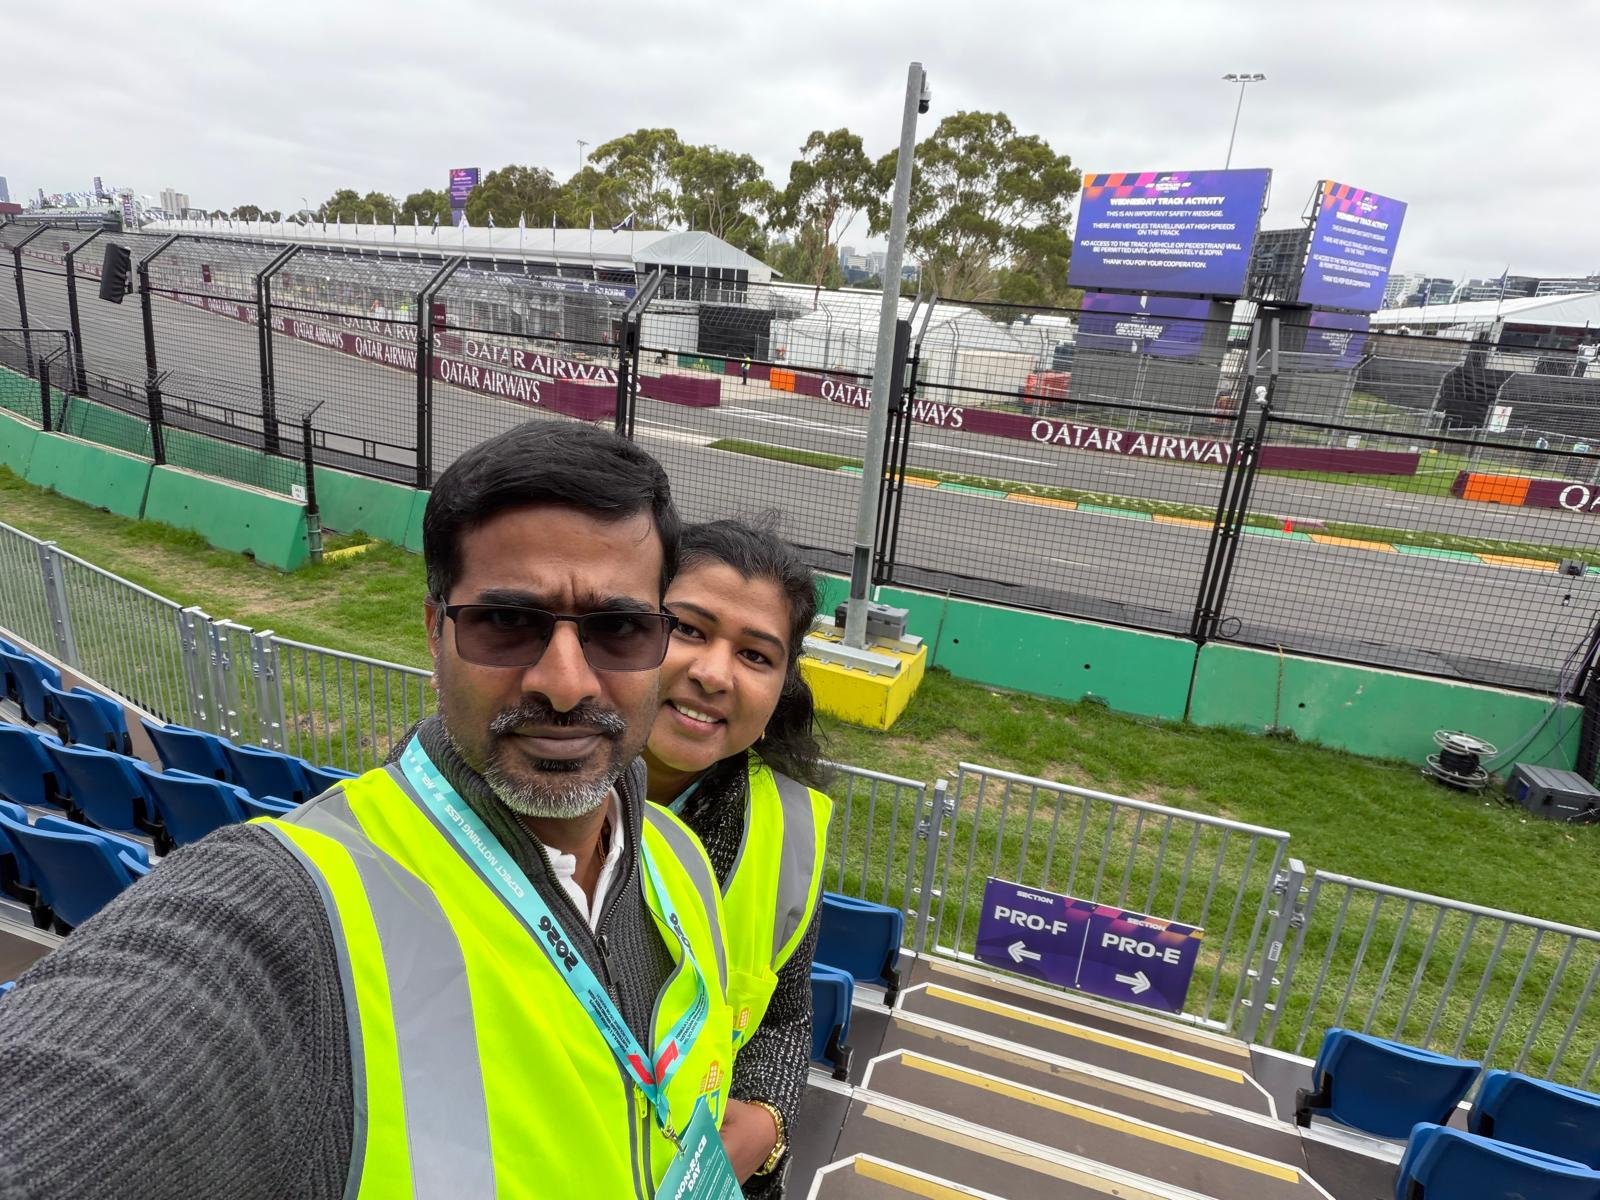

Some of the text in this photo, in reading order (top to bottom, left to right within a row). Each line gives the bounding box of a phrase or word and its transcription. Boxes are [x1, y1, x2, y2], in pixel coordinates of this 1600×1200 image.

[1158, 197, 1184, 206] TRACK
[1185, 196, 1226, 205] ACTIVITY
[355, 336, 418, 370] QATAR AIRWAY
[466, 340, 525, 368] QATAR
[440, 359, 540, 403] QATAR AIRWAYS
[1031, 420, 1122, 453] QATAR
[444, 804, 525, 898] EXPECT NOTHING LESS
[1016, 890, 1054, 904] SECTION
[994, 905, 1068, 936] PRO-F
[1126, 917, 1167, 932] SECTION
[538, 915, 579, 973] 2026
[1101, 933, 1181, 965] PRO-E
[687, 1161, 700, 1192] DAY
